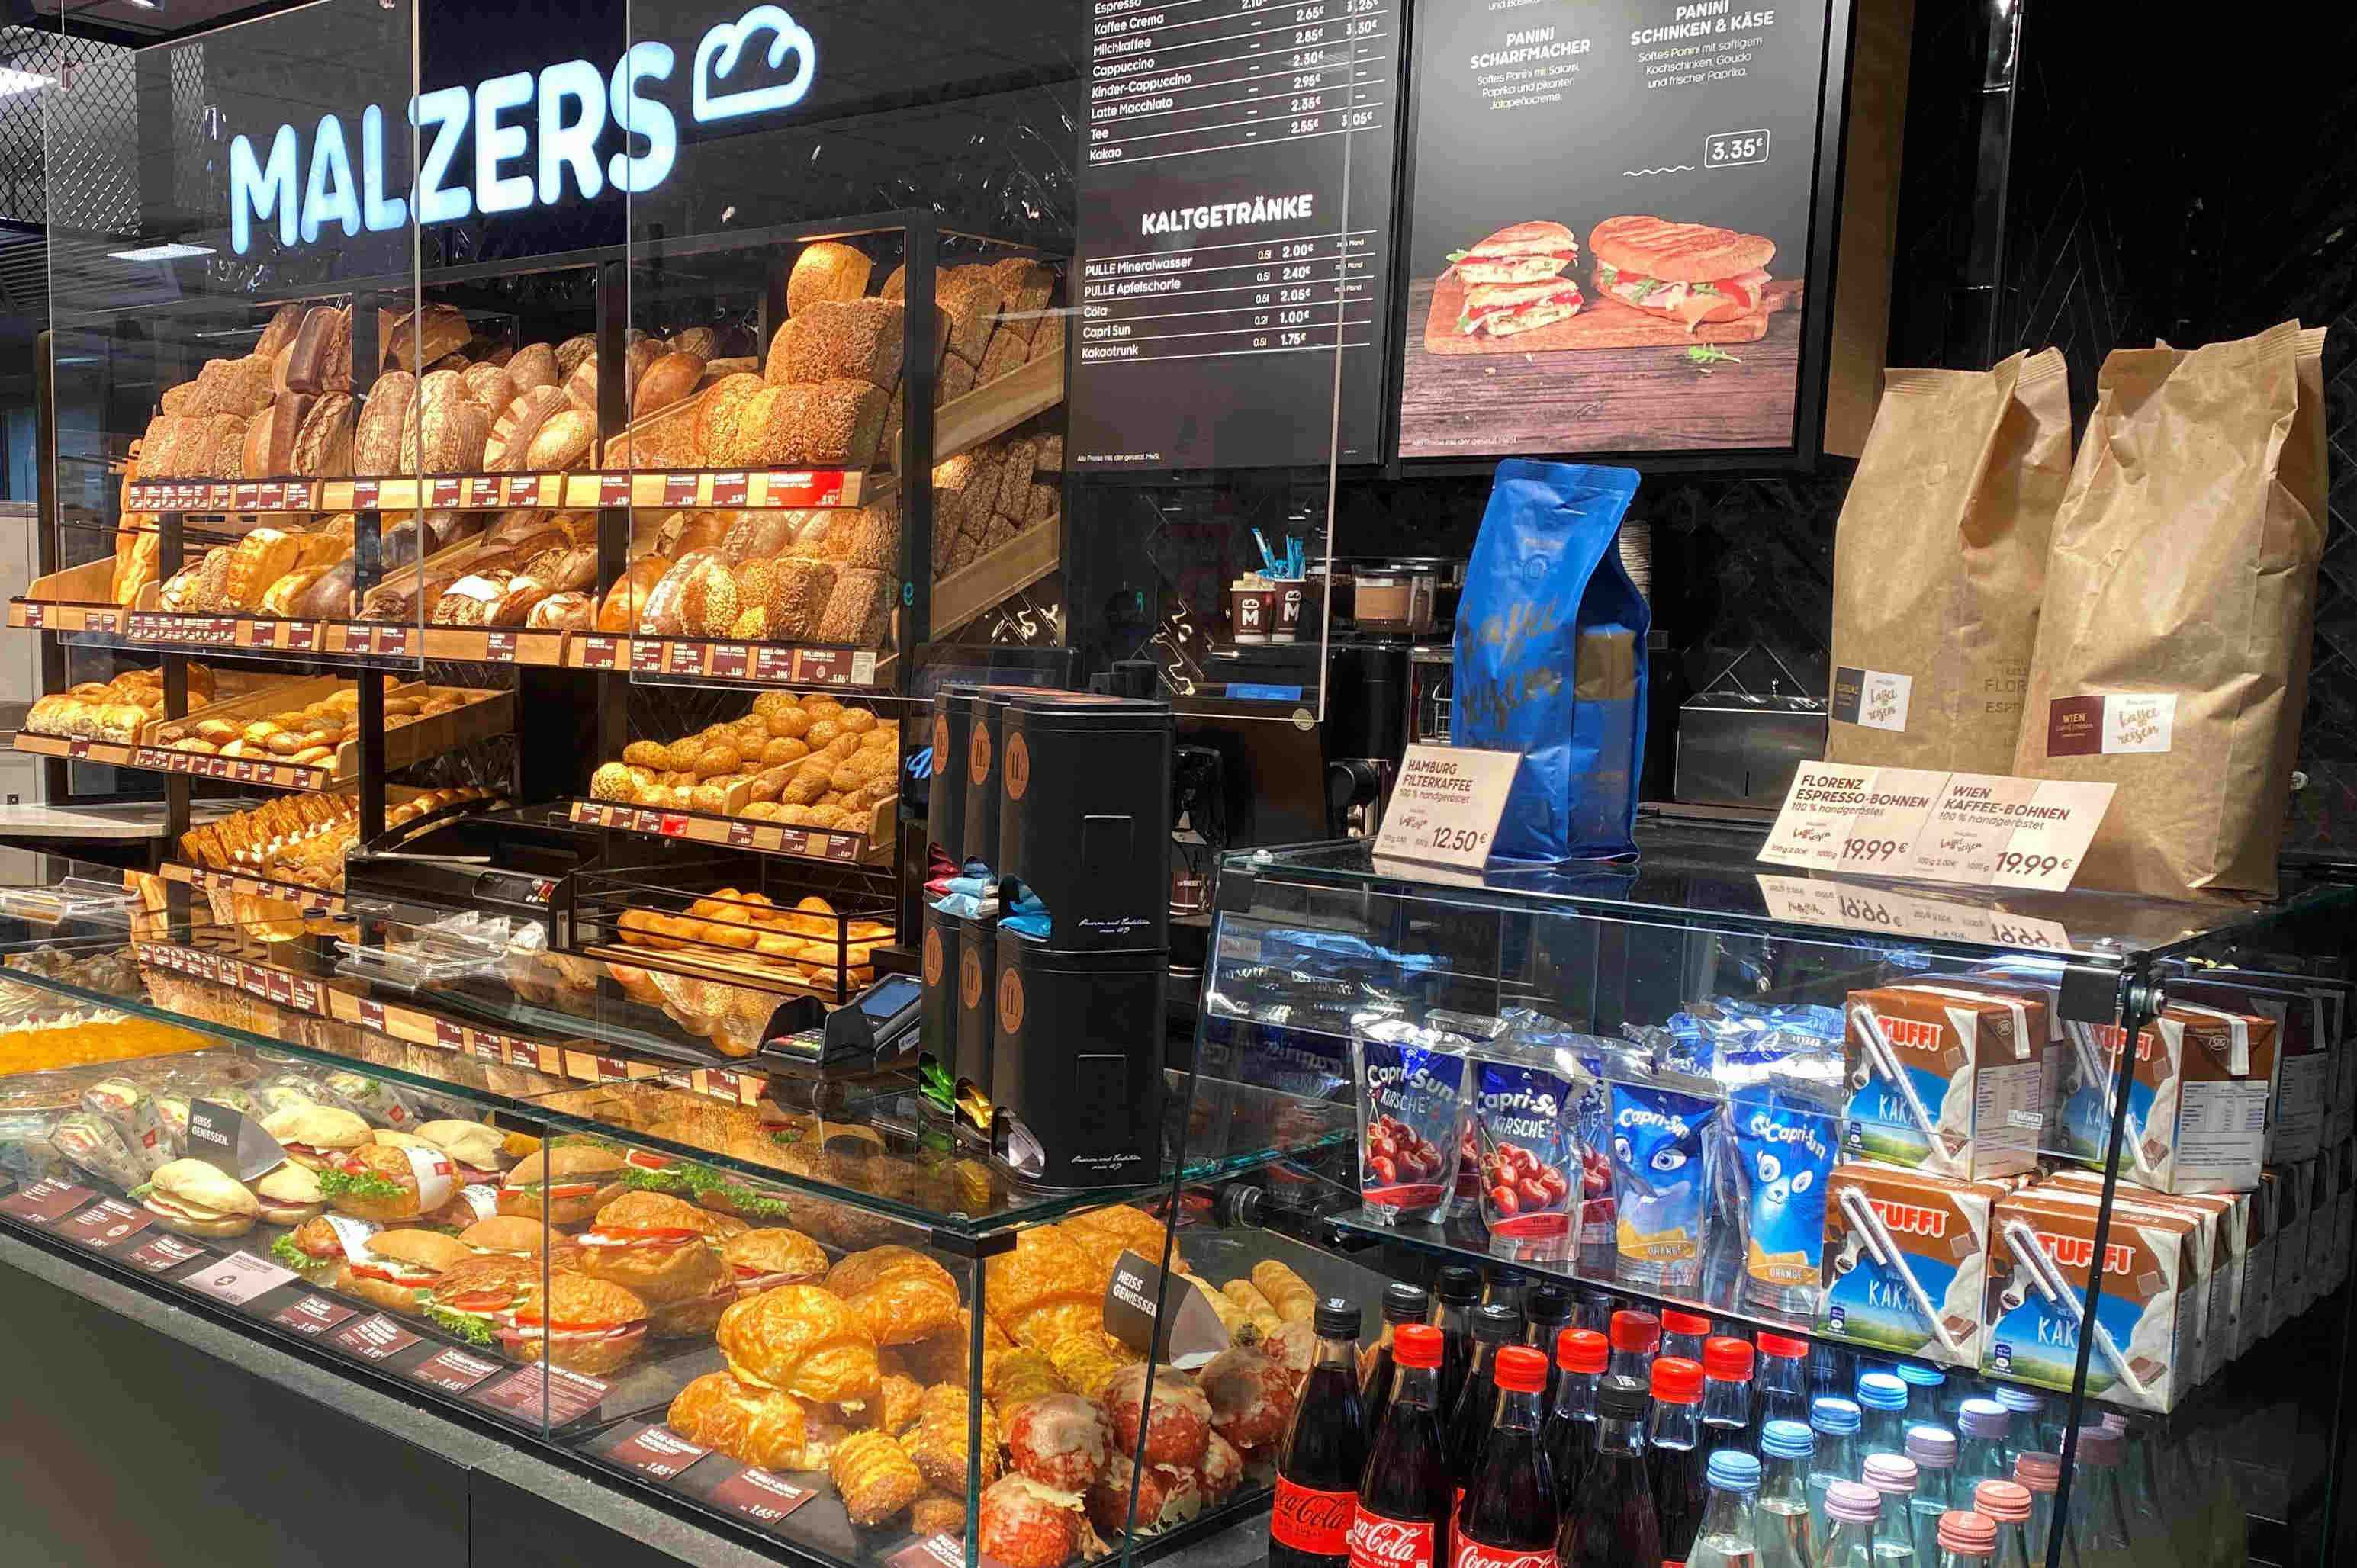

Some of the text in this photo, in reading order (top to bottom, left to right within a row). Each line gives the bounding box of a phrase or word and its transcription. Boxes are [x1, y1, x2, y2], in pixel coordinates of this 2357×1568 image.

[1095, 0, 1143, 14] Espresso
[1676, 0, 1729, 21] PANINI
[1093, 38, 1152, 56] Milchkaffee
[1297, 6, 1324, 21] 2.65€
[1094, 21, 1127, 36] Kaffee
[1130, 14, 1165, 30] Crema
[1631, 11, 1775, 46] SCHINKEN & KÄSE
[1506, 26, 1555, 47] PANINI
[1471, 39, 1591, 69] SCHARFMACHER
[1671, 44, 1700, 58] Panini
[1716, 53, 1752, 66] Gouda
[1092, 58, 1155, 77] Cappuccino
[1092, 73, 1192, 98] Kinder-Cappuccino
[1518, 82, 1535, 94] und
[1648, 76, 1667, 89] und
[1091, 105, 1117, 120] Latte
[1119, 97, 1174, 115] Macchiato
[1089, 147, 1122, 161] Kakao
[1342, 111, 1373, 127] 305€
[1091, 128, 1109, 140] Tee
[230, 40, 677, 255] MALZERS
[1712, 137, 1763, 160] 3.35€
[1142, 194, 1314, 236] KALTGETRÄNKE
[1085, 264, 1116, 277] PULLE
[1117, 256, 1193, 275] Mineralwasser
[1085, 284, 1115, 297] PULLE
[1117, 278, 1182, 297] Apfelschorle
[1084, 306, 1108, 318] Cola
[1083, 325, 1111, 339] Capri
[1112, 325, 1131, 336] Sun
[1082, 344, 1139, 359] Kakaotrunk
[1985, 679, 2027, 693] FLOR
[1986, 702, 2023, 714] ESPR
[2063, 714, 2087, 724] WIEN
[1407, 758, 1458, 775] HAMBURG
[1402, 774, 1474, 792] FILTERKAFFEE
[1801, 775, 1866, 790] FLORENZ
[1953, 785, 1992, 799] WIEN
[1792, 802, 1808, 811] 100
[1809, 803, 1818, 812] %
[1796, 789, 1930, 808] ESPRESSO-BOHNEN
[1945, 798, 2072, 821] KAFFEE-BOHNEN
[1938, 811, 2046, 831] 100 % handgeröstet
[1876, 1015, 1942, 1052] TUFFI
[1367, 1065, 1455, 1103] Capri-Sun
[1380, 1087, 1426, 1113] KIRSCHE
[1491, 1114, 1547, 1139] KIRSCHE
[1619, 1108, 1691, 1139] Capri-Sun
[1765, 1123, 1827, 1160] Capri-Sun
[1869, 1198, 1944, 1239] TUFFI
[1117, 1269, 1143, 1292] HEISS
[1112, 1284, 1157, 1318] GENIESSEN
[2037, 1316, 2081, 1349] KAK
